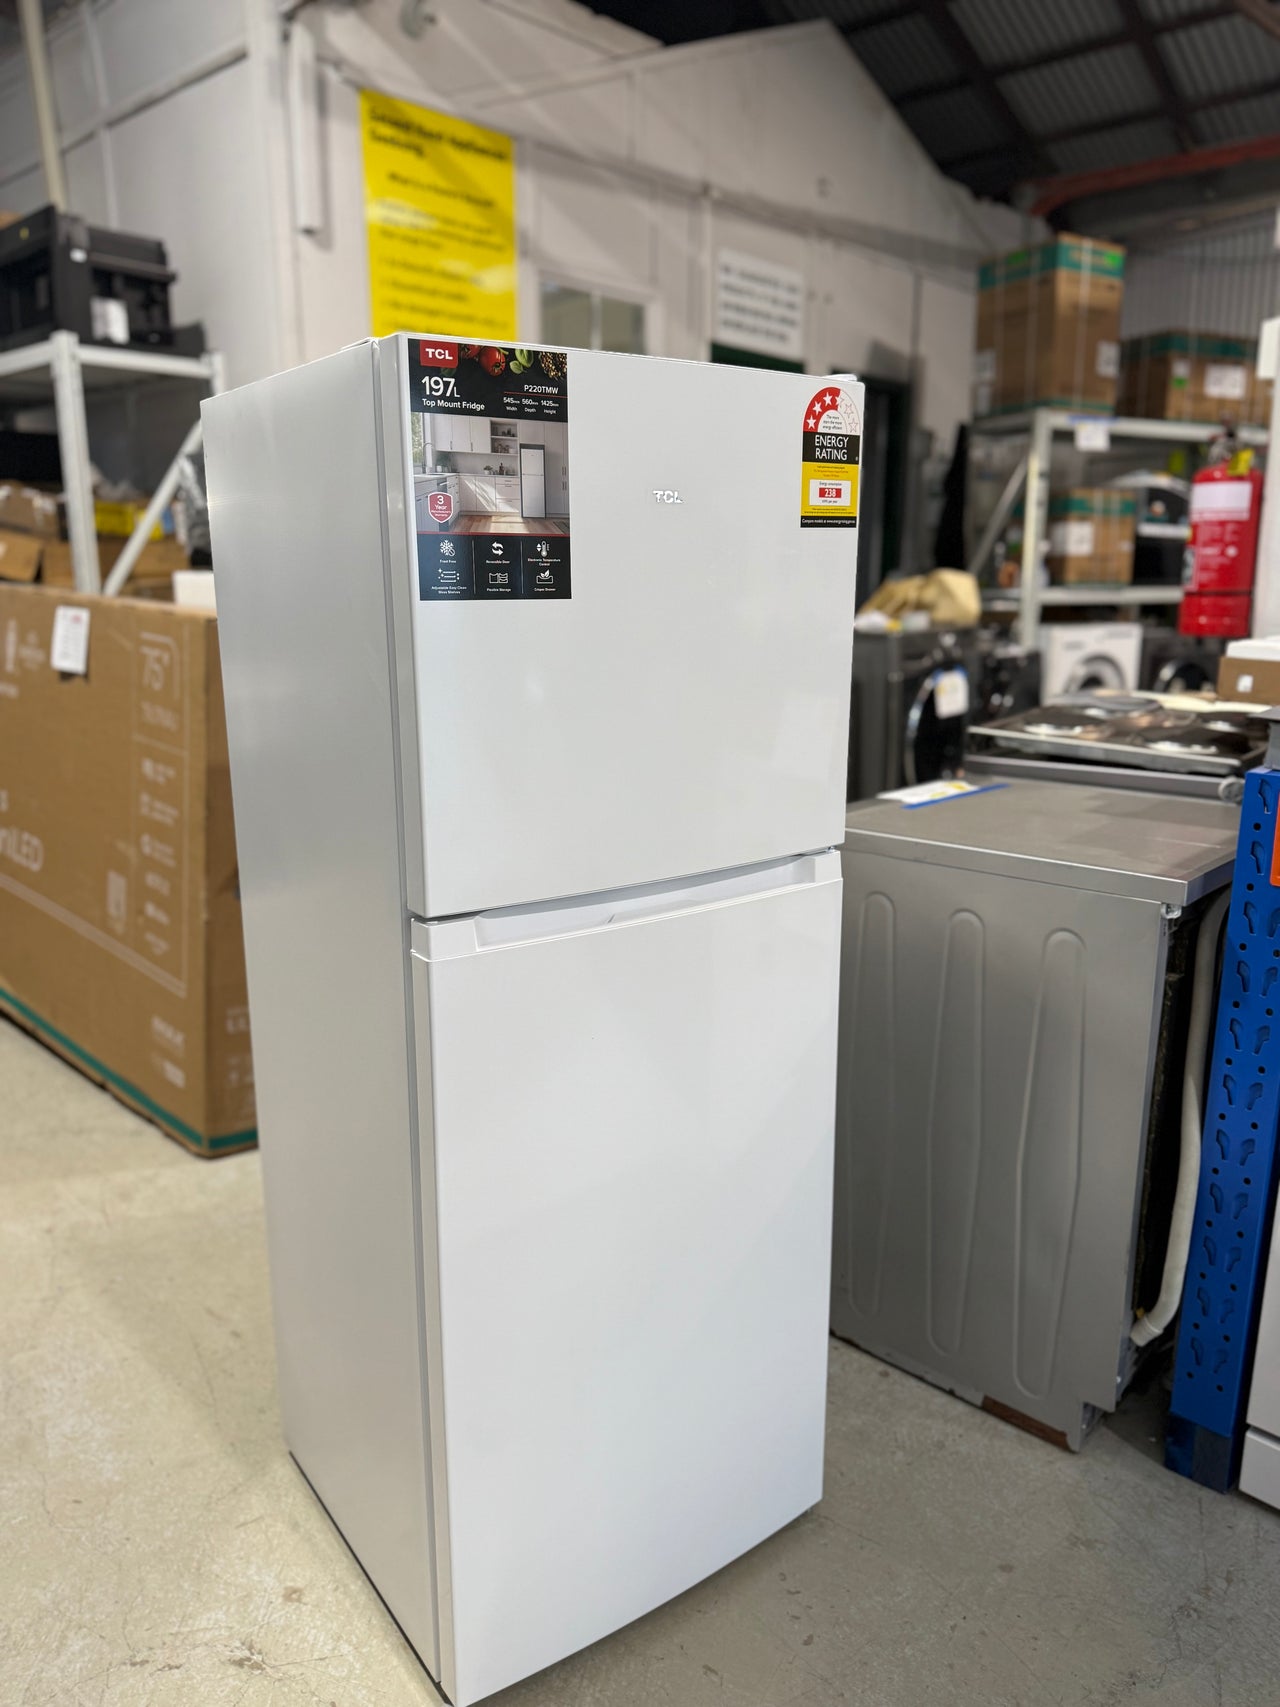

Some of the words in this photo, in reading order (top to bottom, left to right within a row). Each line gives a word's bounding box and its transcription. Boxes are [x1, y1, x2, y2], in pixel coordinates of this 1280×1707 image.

[425, 348, 454, 360] TCL
[421, 375, 461, 398] 197L
[524, 384, 559, 395] P220TMW
[422, 399, 436, 408] Top
[437, 400, 461, 409] Mount
[462, 402, 485, 412] Fridge
[814, 434, 849, 448] ENERGY
[815, 447, 848, 461] RATING
[437, 495, 444, 504] 3
[653, 490, 684, 503] TCL
